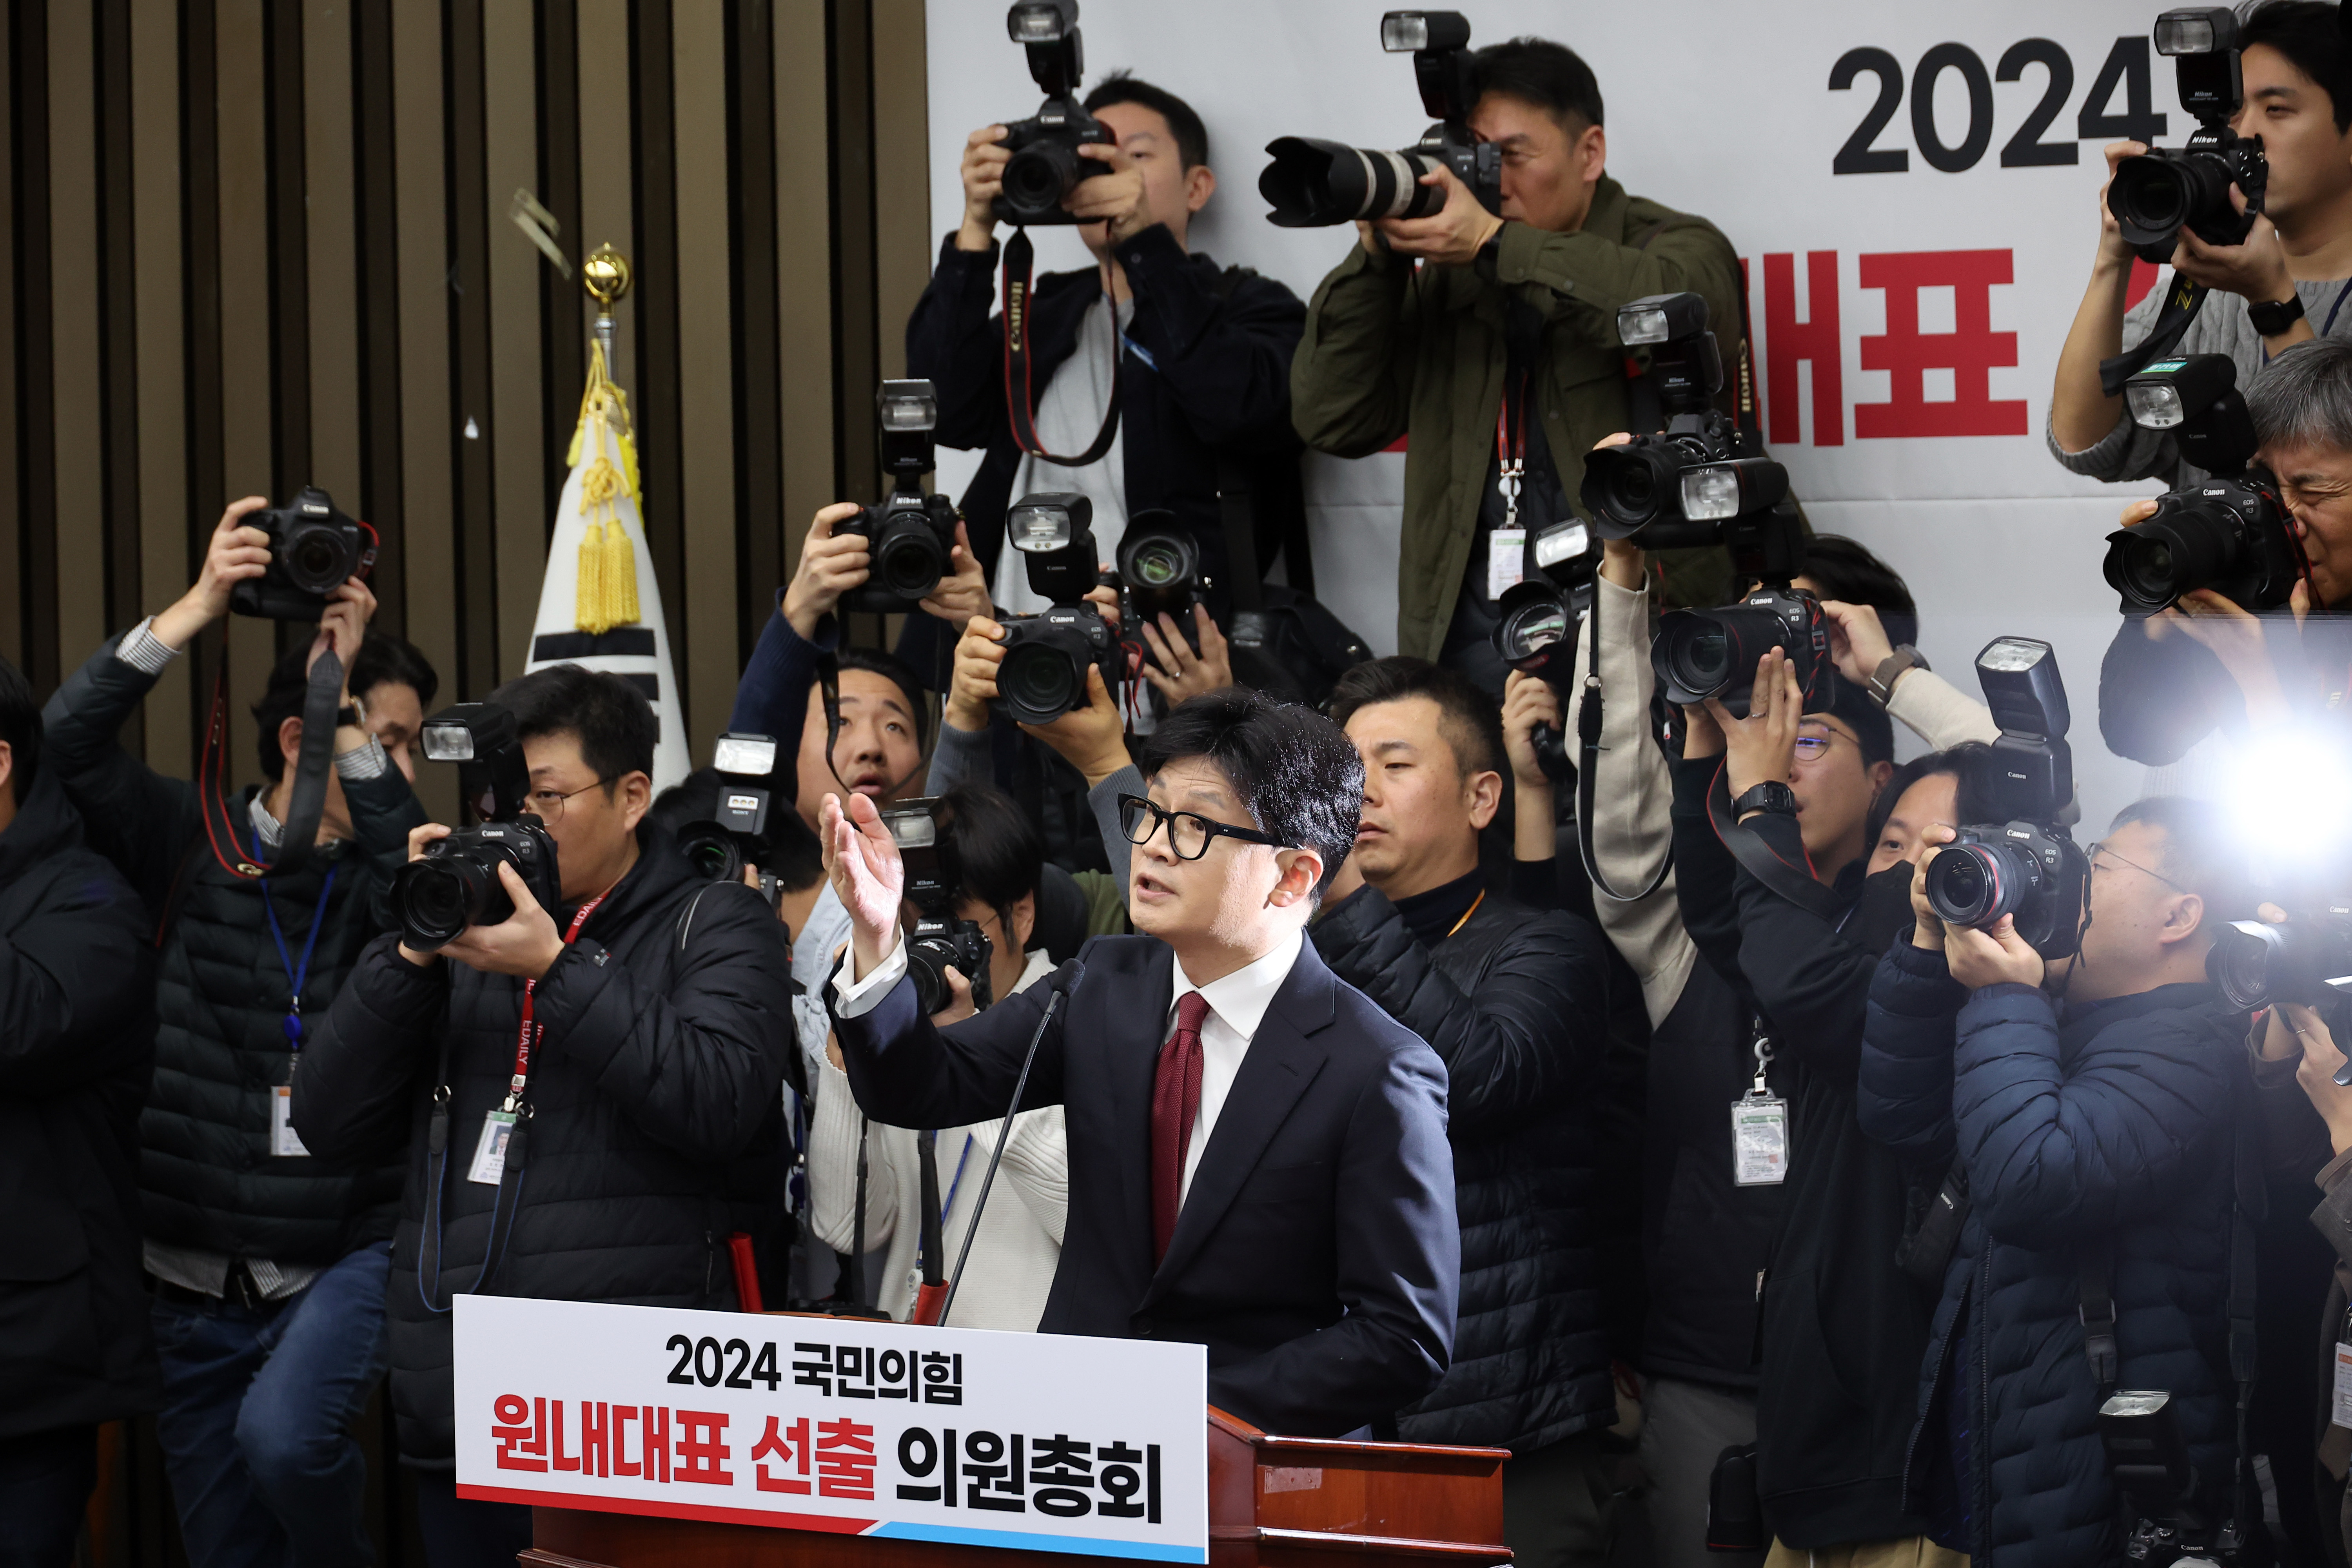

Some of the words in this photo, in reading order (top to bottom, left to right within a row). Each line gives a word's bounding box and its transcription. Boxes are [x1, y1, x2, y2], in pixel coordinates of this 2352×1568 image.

[1828, 35, 2167, 175] 2024
[2007, 771, 2027, 780] Canon
[2007, 829, 2031, 839] Canon
[2329, 906, 2349, 914] Canon
[519, 1020, 532, 1065] EDAILY
[666, 1334, 781, 1391] 2024
[793, 1343, 962, 1406] 국민의힘
[492, 1394, 733, 1485] 원내대표
[752, 1416, 877, 1501] 선출
[897, 1427, 1161, 1524] 의원총회
